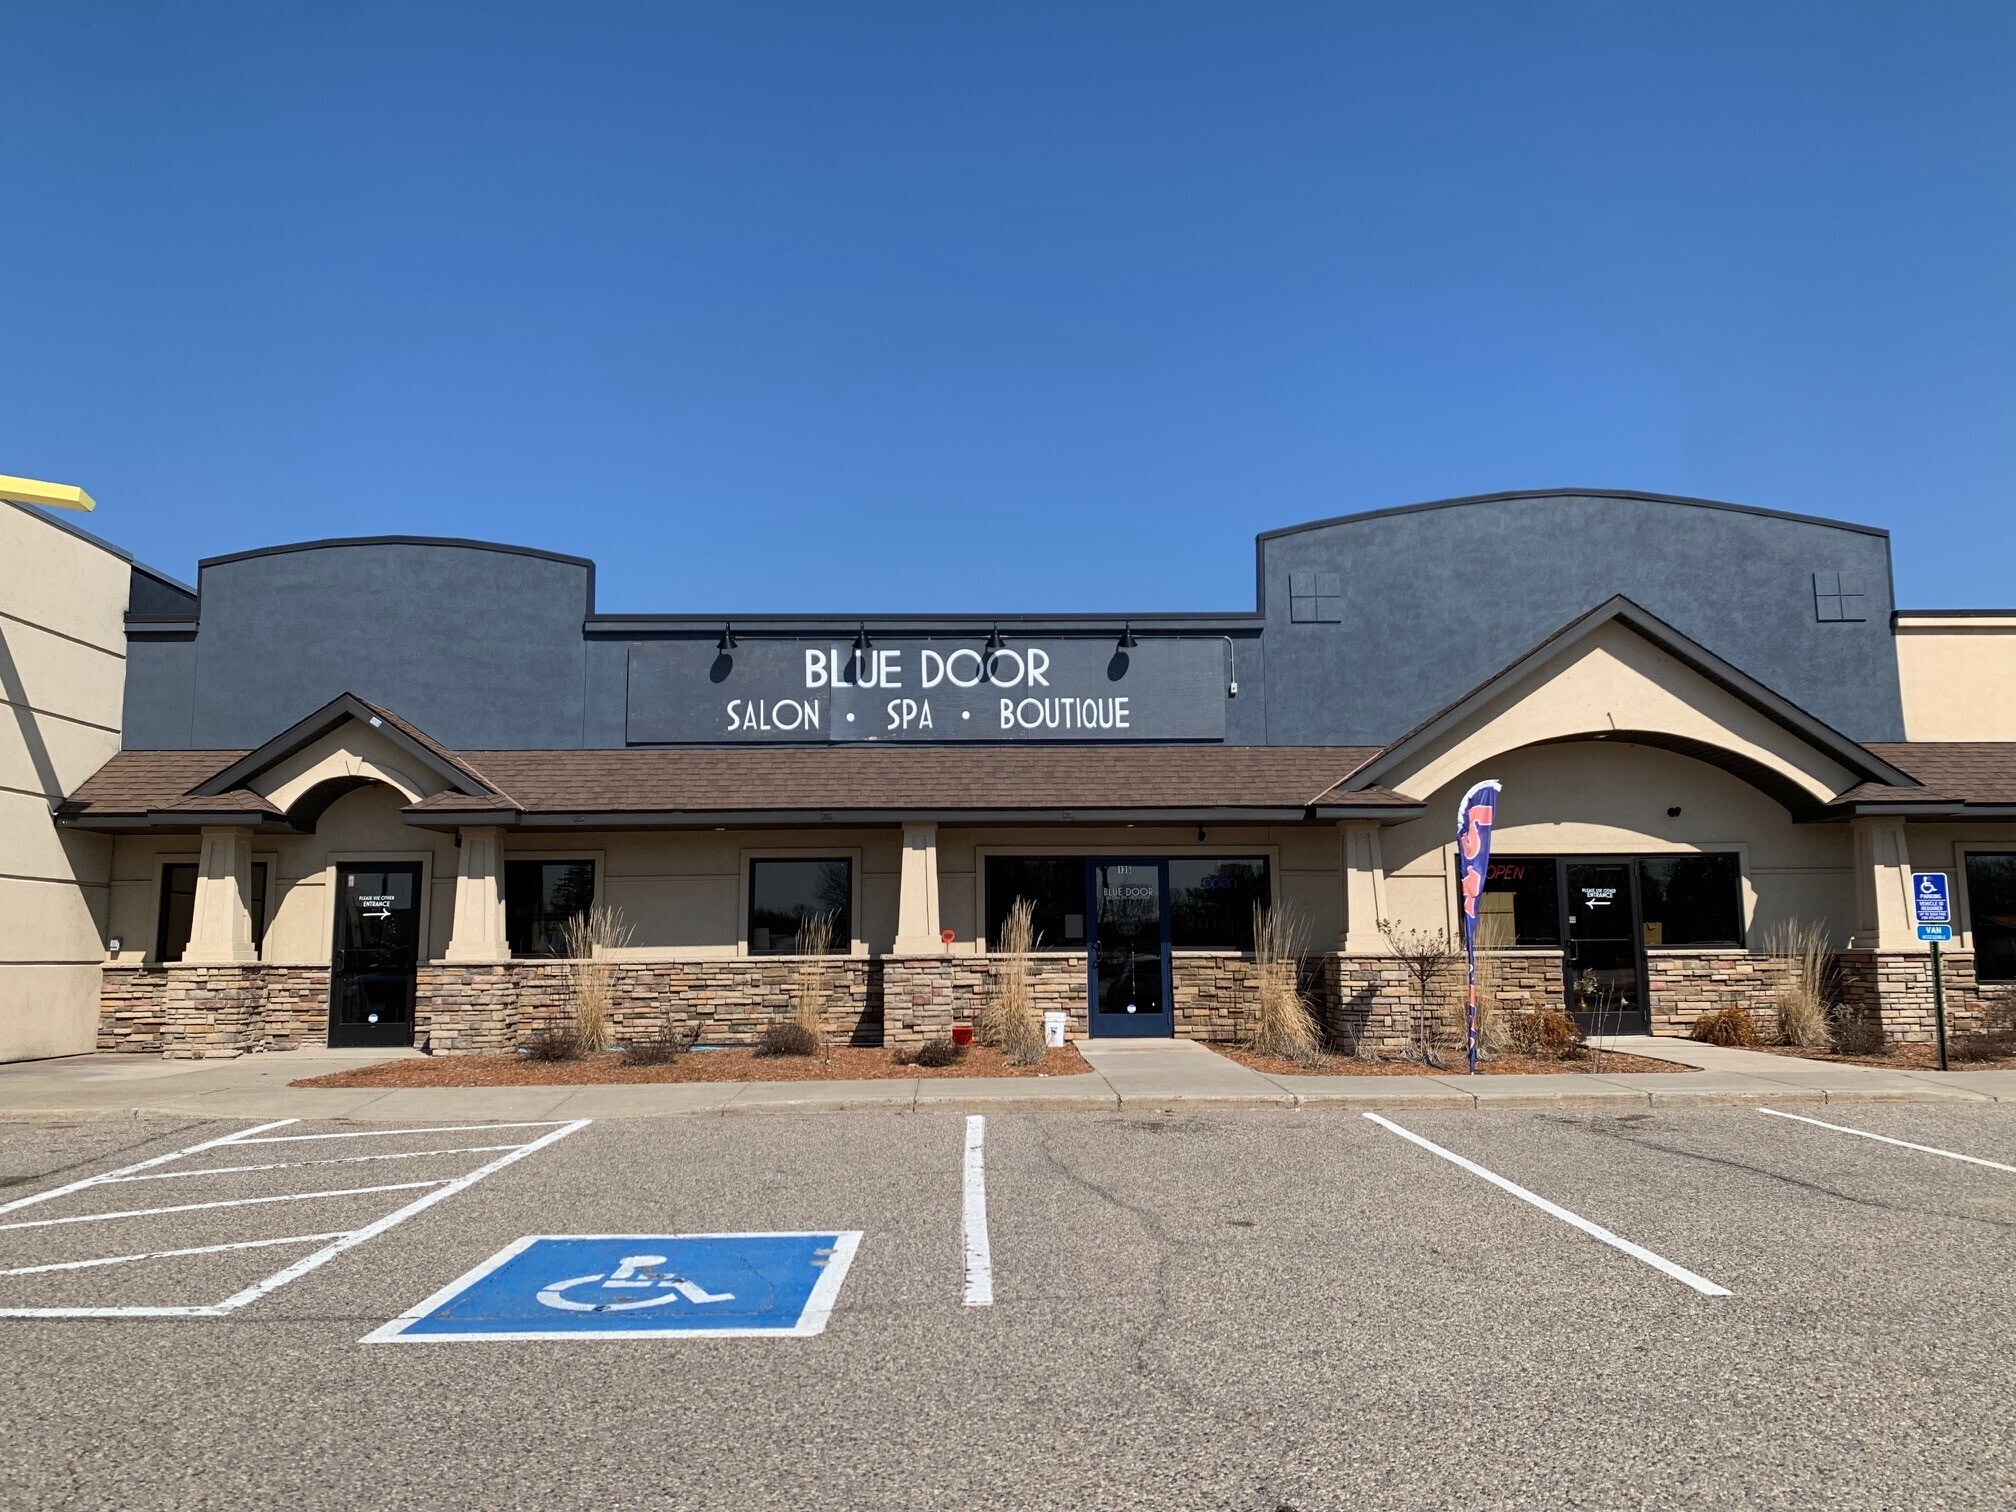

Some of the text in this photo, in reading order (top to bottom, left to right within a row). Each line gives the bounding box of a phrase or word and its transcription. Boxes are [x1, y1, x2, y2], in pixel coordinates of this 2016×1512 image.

[805, 648, 1050, 688] BLUE DOOR
[726, 697, 1131, 731] SALON SPA BOUTIQUE
[1118, 866, 1132, 874] 135
[1486, 865, 1526, 880] OPEN
[1203, 878, 1237, 890] open
[1103, 887, 1154, 896] BLUE DOOR
[1925, 926, 1942, 934] VAN
